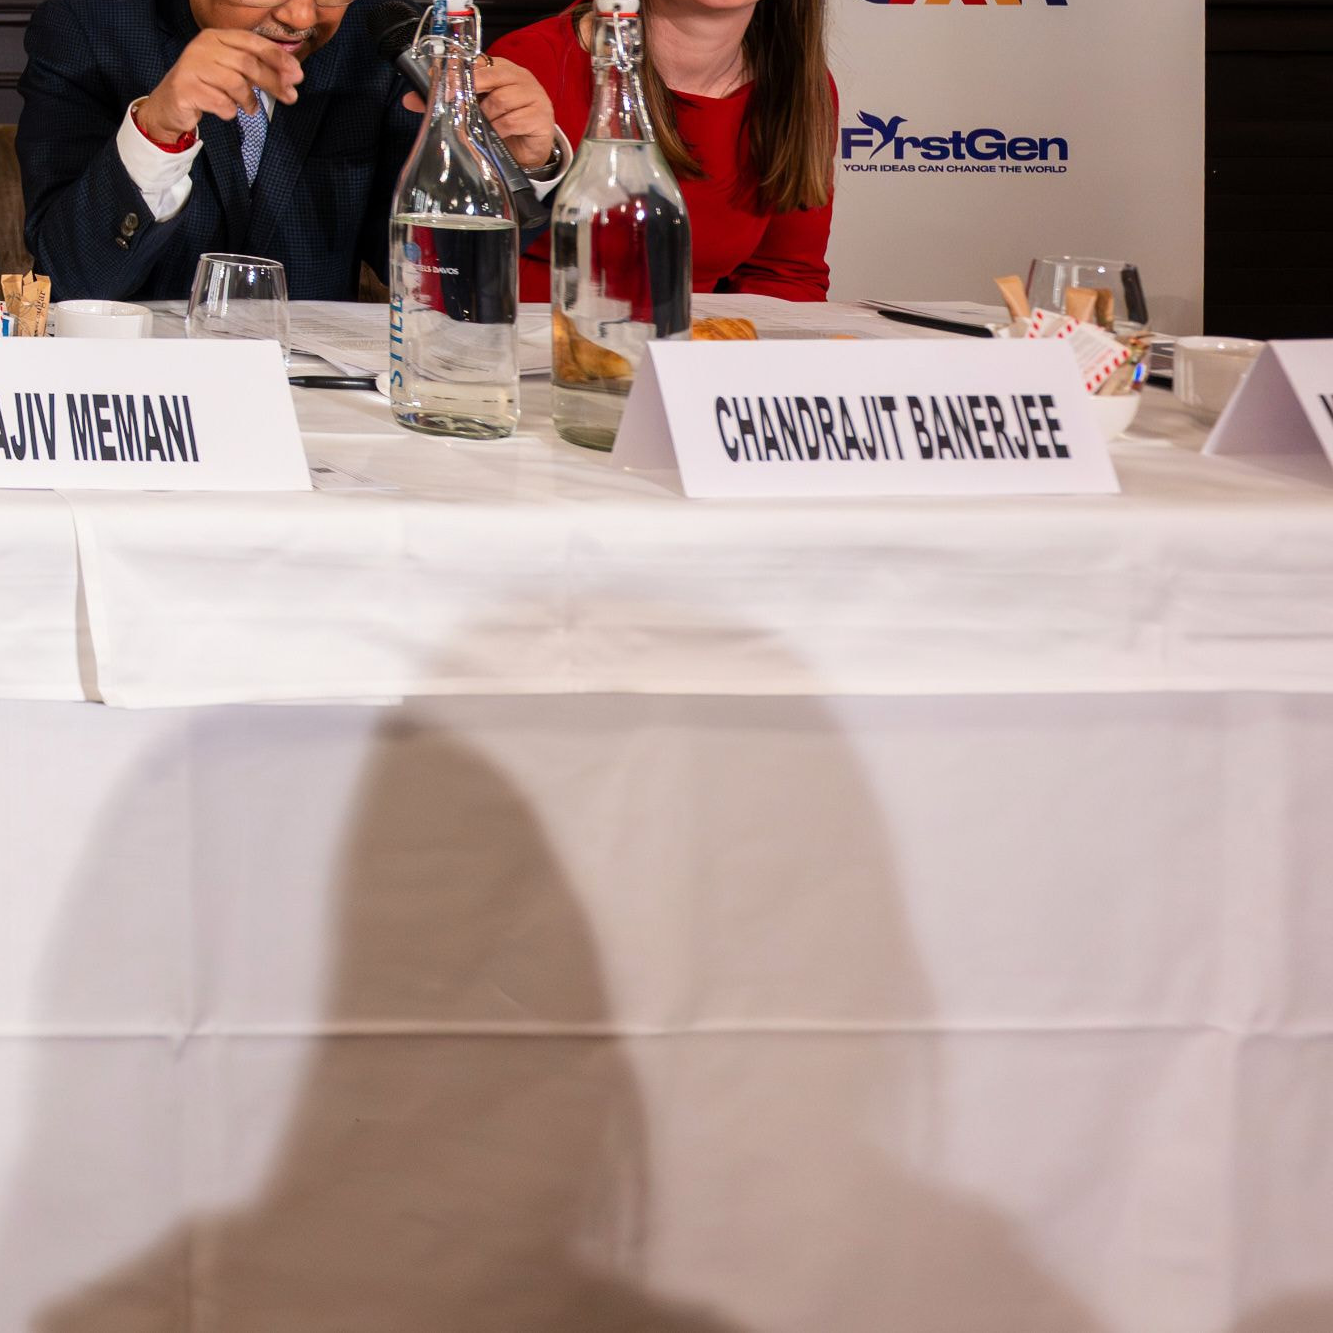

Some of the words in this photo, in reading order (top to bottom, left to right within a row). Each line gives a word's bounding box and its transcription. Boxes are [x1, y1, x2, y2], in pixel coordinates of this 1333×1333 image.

[843, 164, 878, 173] YOUR
[879, 164, 916, 173] IDEAS
[917, 164, 944, 173] CAN
[946, 165, 997, 173] CHANGE
[998, 165, 1022, 173] THE
[1023, 165, 1068, 174] WORLD
[66, 393, 201, 463] MEMANI
[714, 394, 905, 463] CHANDRAJIT
[905, 394, 1072, 460] BANERJEE
